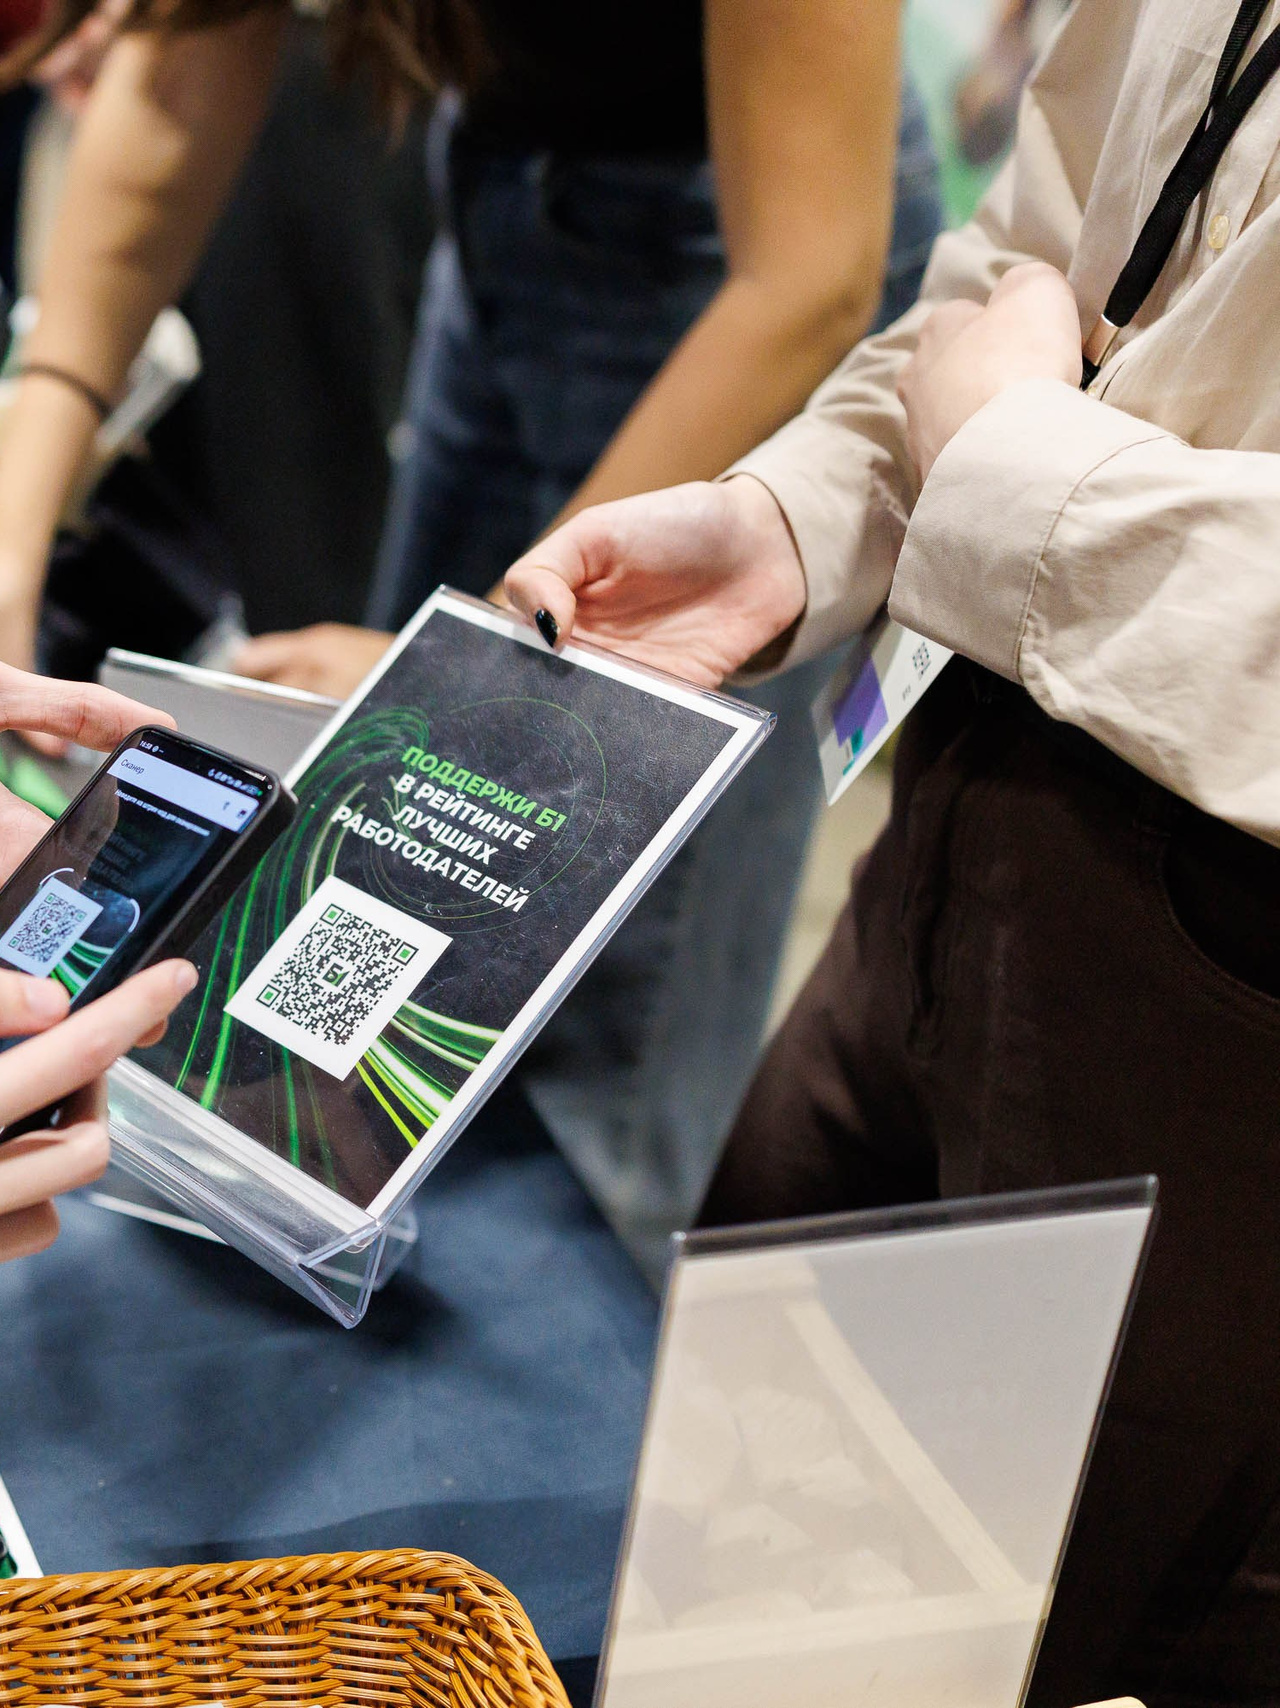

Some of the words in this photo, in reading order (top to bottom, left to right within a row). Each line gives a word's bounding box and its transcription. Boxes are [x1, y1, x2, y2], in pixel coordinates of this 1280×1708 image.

[120, 759, 145, 775] Сканер
[401, 746, 538, 818] ПОДДЕРЖИ
[534, 806, 568, 832] Б1
[392, 805, 499, 865] ЛУЧШИХ
[394, 773, 417, 794] В
[413, 782, 536, 851] РЕЙТИНГЕ
[330, 806, 529, 912] РАБОТОДАТЕЛЕЙ
